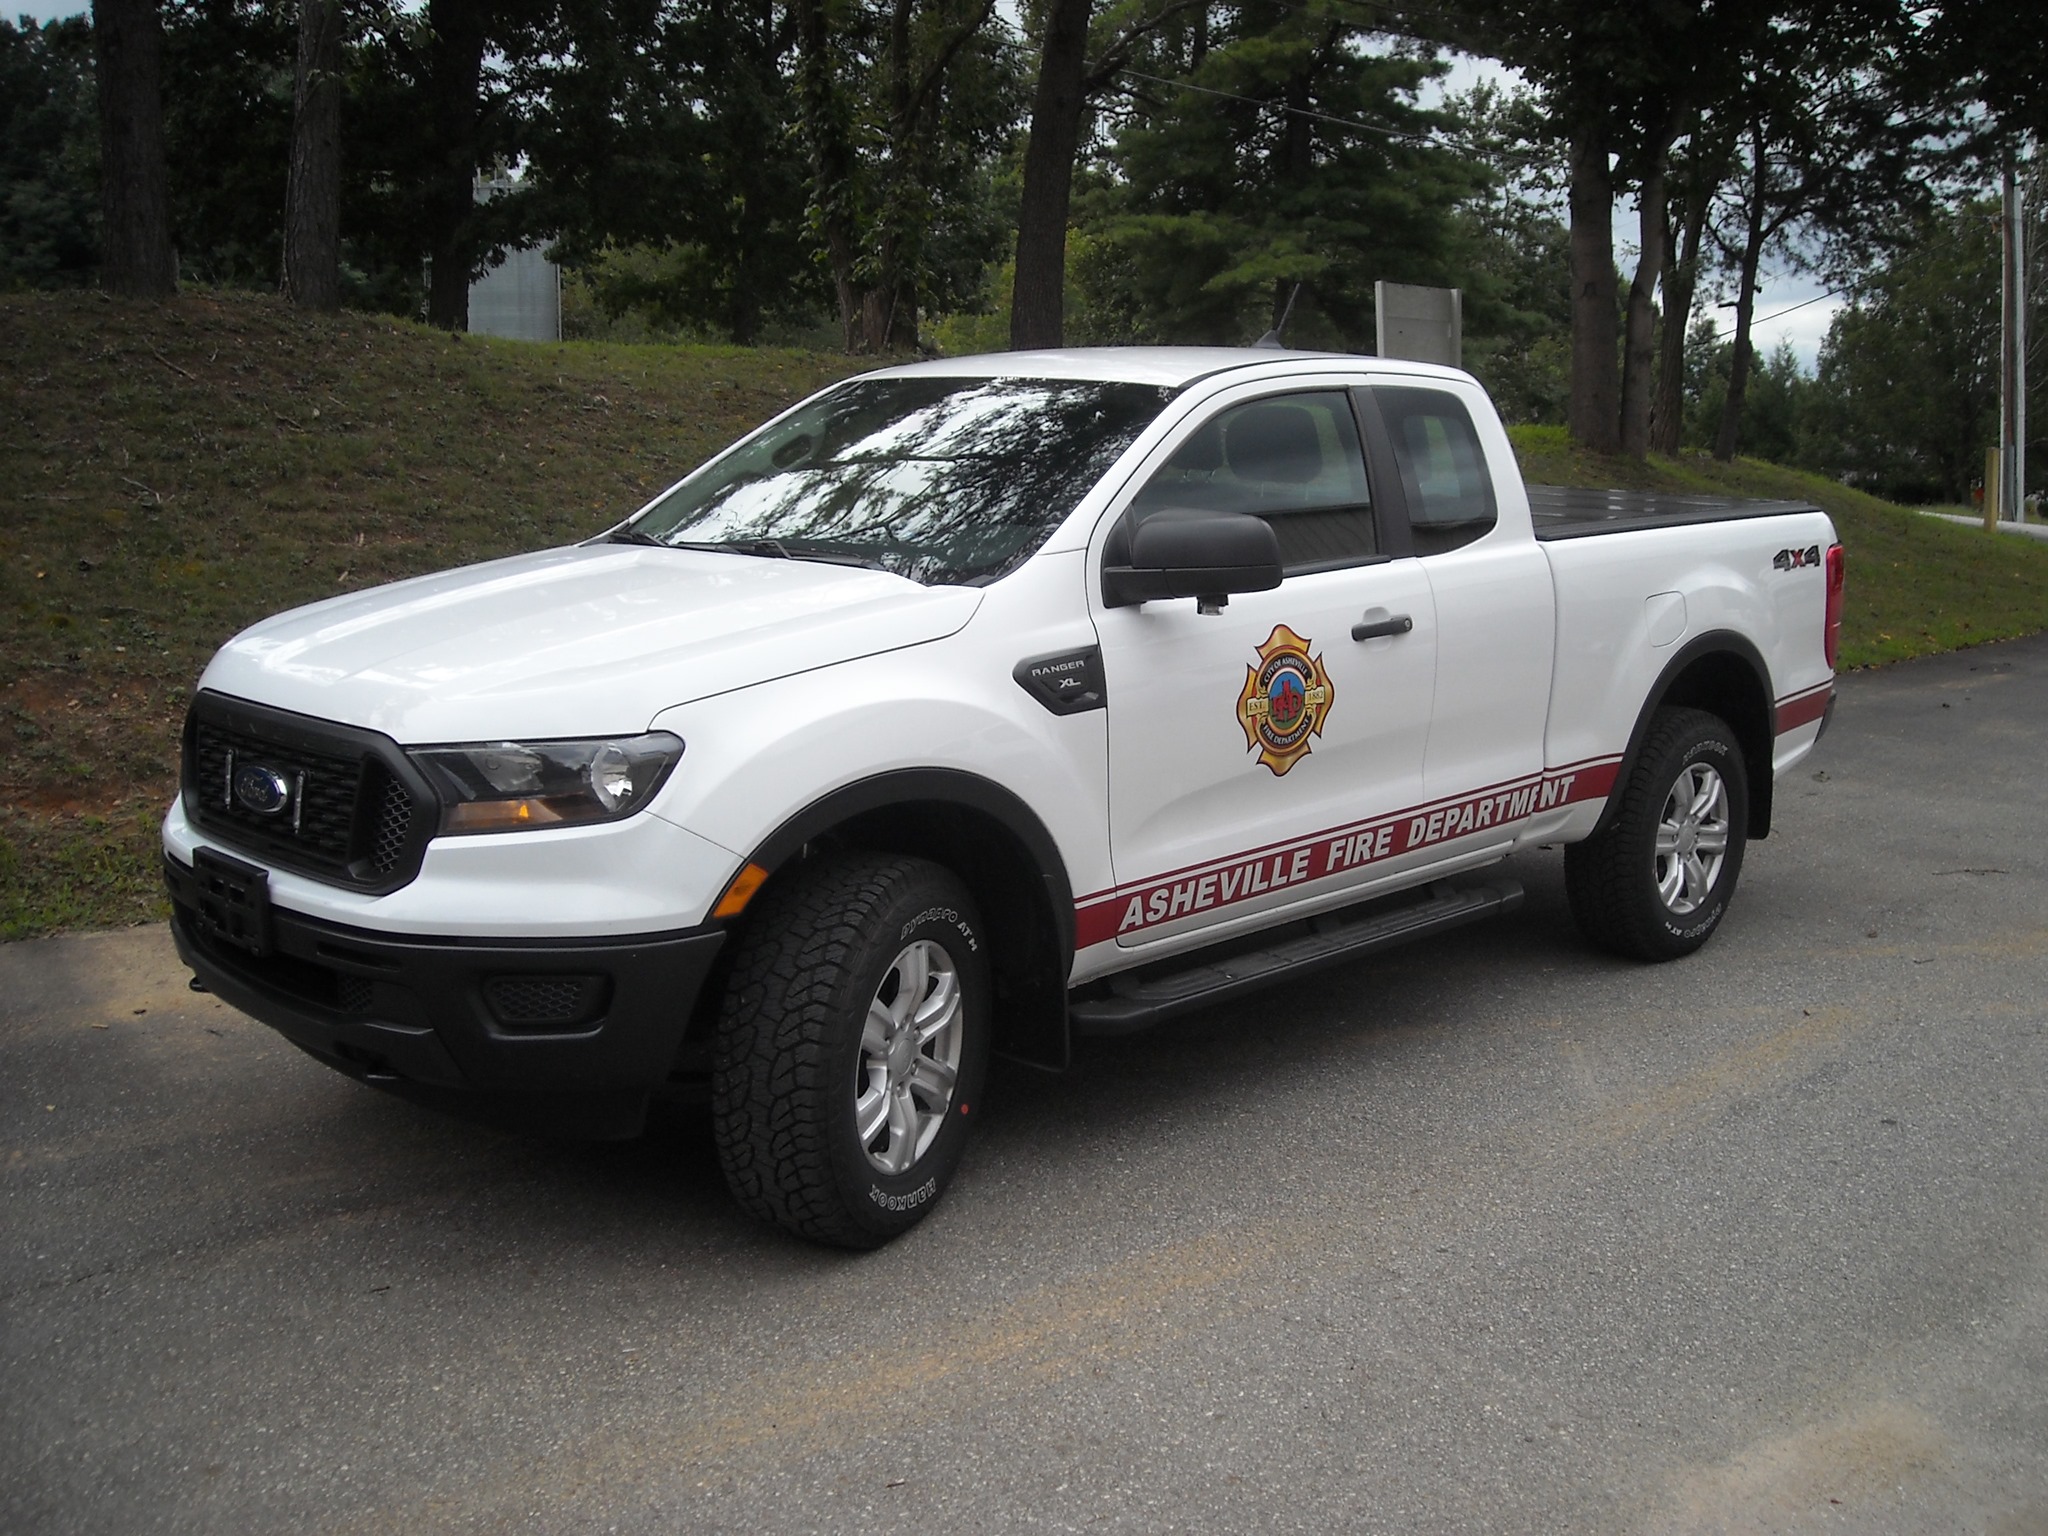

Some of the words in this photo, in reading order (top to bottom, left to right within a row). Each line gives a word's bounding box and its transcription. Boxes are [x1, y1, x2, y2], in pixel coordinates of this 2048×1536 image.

[1031, 660, 1085, 677] RANGER
[1264, 664, 1275, 682] CITY
[1282, 657, 1307, 675] ASHEVILLE
[1059, 678, 1081, 688] XL
[1308, 690, 1324, 701] 1882
[1263, 725, 1274, 741] FIRE
[1273, 718, 1309, 745] DEPARTMENT
[1118, 848, 1312, 932] ASHEVILLE
[1325, 825, 1394, 871] FIRE
